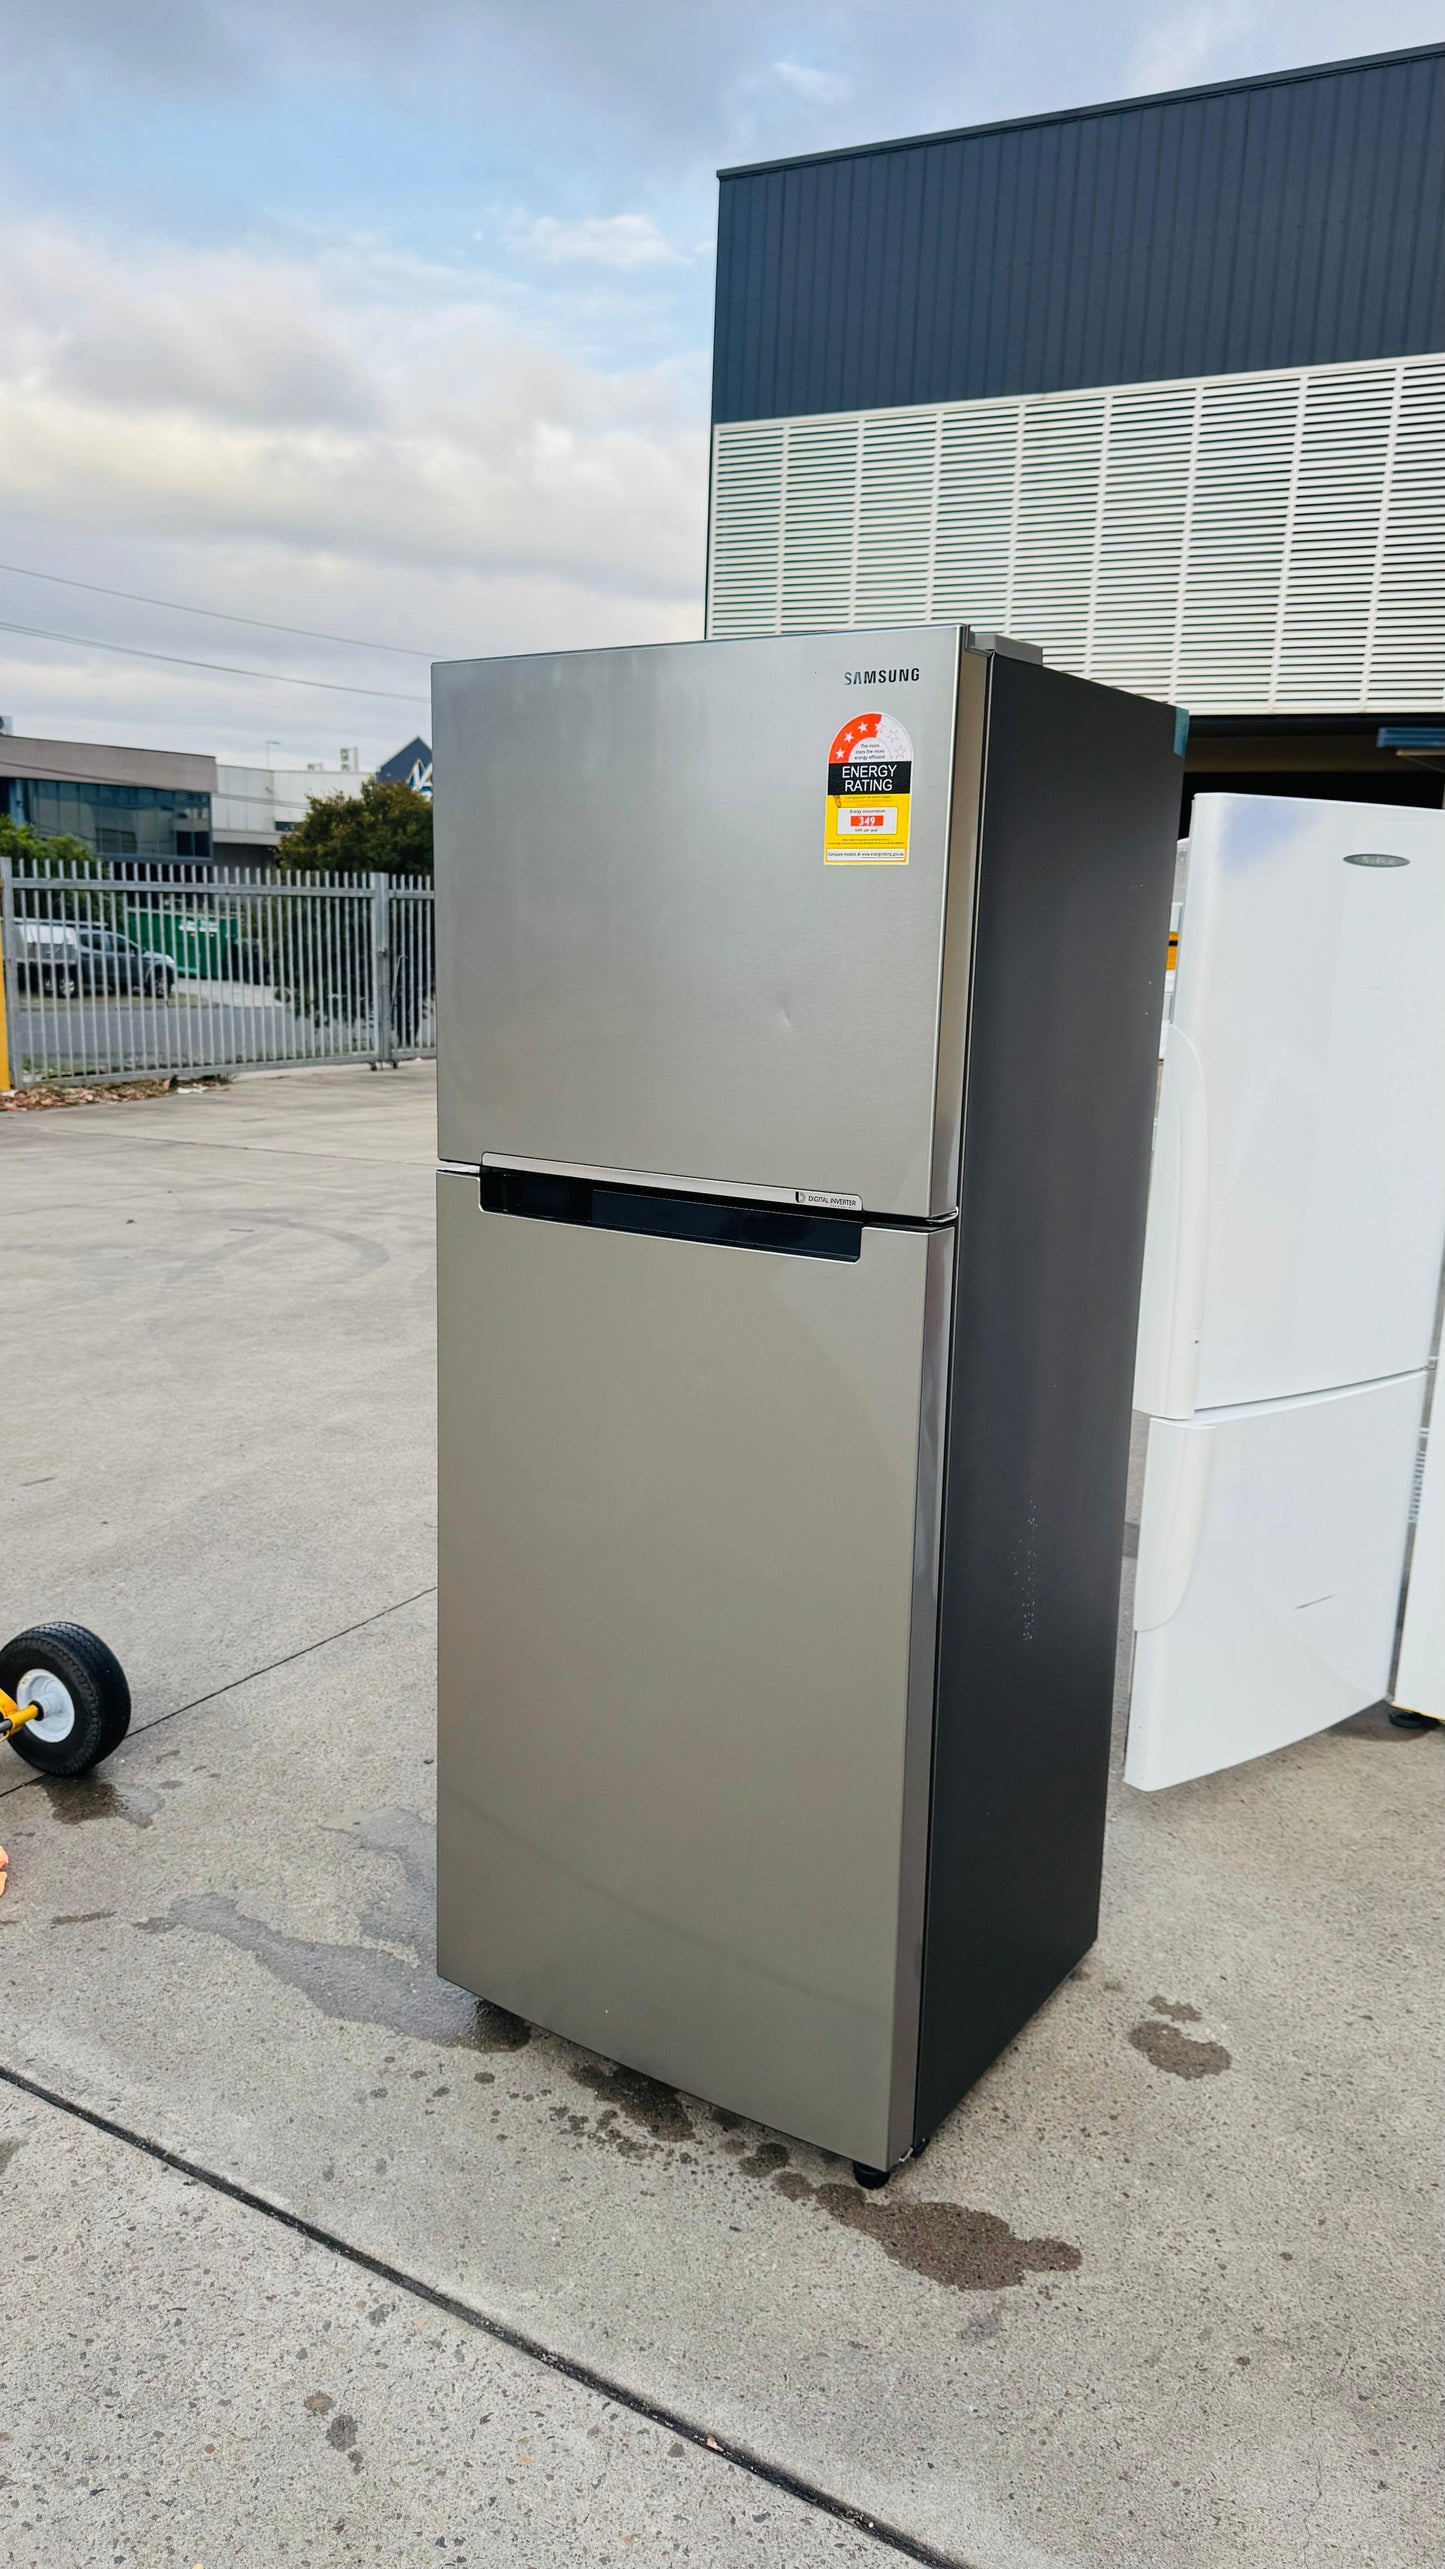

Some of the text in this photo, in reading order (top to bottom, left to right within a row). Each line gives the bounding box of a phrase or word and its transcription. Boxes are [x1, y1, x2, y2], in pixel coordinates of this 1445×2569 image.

[844, 667, 920, 686] SAMSUNG
[842, 764, 897, 779] ENERGY
[844, 778, 893, 792] RATING
[858, 816, 876, 826] 349
[808, 1196, 829, 1204] DIGITAL
[830, 1198, 857, 1207] INVERTER
